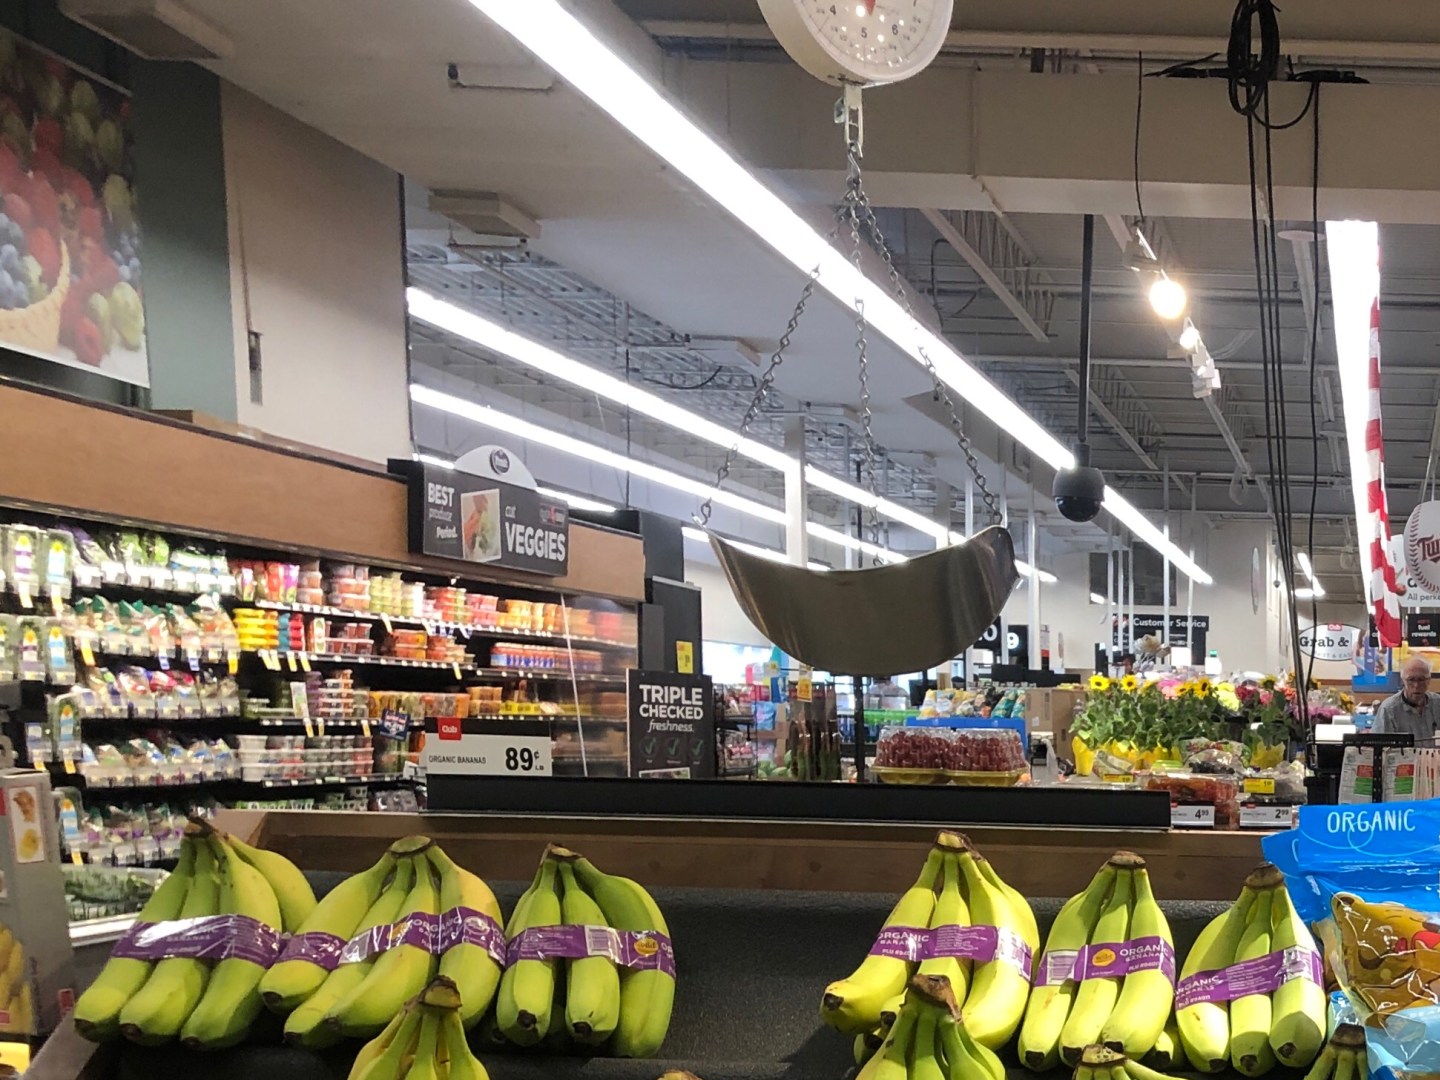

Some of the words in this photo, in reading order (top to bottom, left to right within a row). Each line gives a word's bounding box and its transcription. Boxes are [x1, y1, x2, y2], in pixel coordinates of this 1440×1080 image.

[860, 27, 868, 38] 5
[892, 24, 898, 35] 6
[428, 483, 454, 506] BEST
[505, 522, 566, 562] VEGGIES
[1338, 637, 1350, 647] &
[639, 684, 704, 706] TRIPLE
[639, 704, 704, 720] CHECKED
[648, 720, 694, 734] freshness.
[428, 755, 456, 764] ORGANIC
[457, 756, 486, 765] BANANAS
[1327, 808, 1416, 834] ORGANIC
[878, 931, 930, 943] ORGANIC
